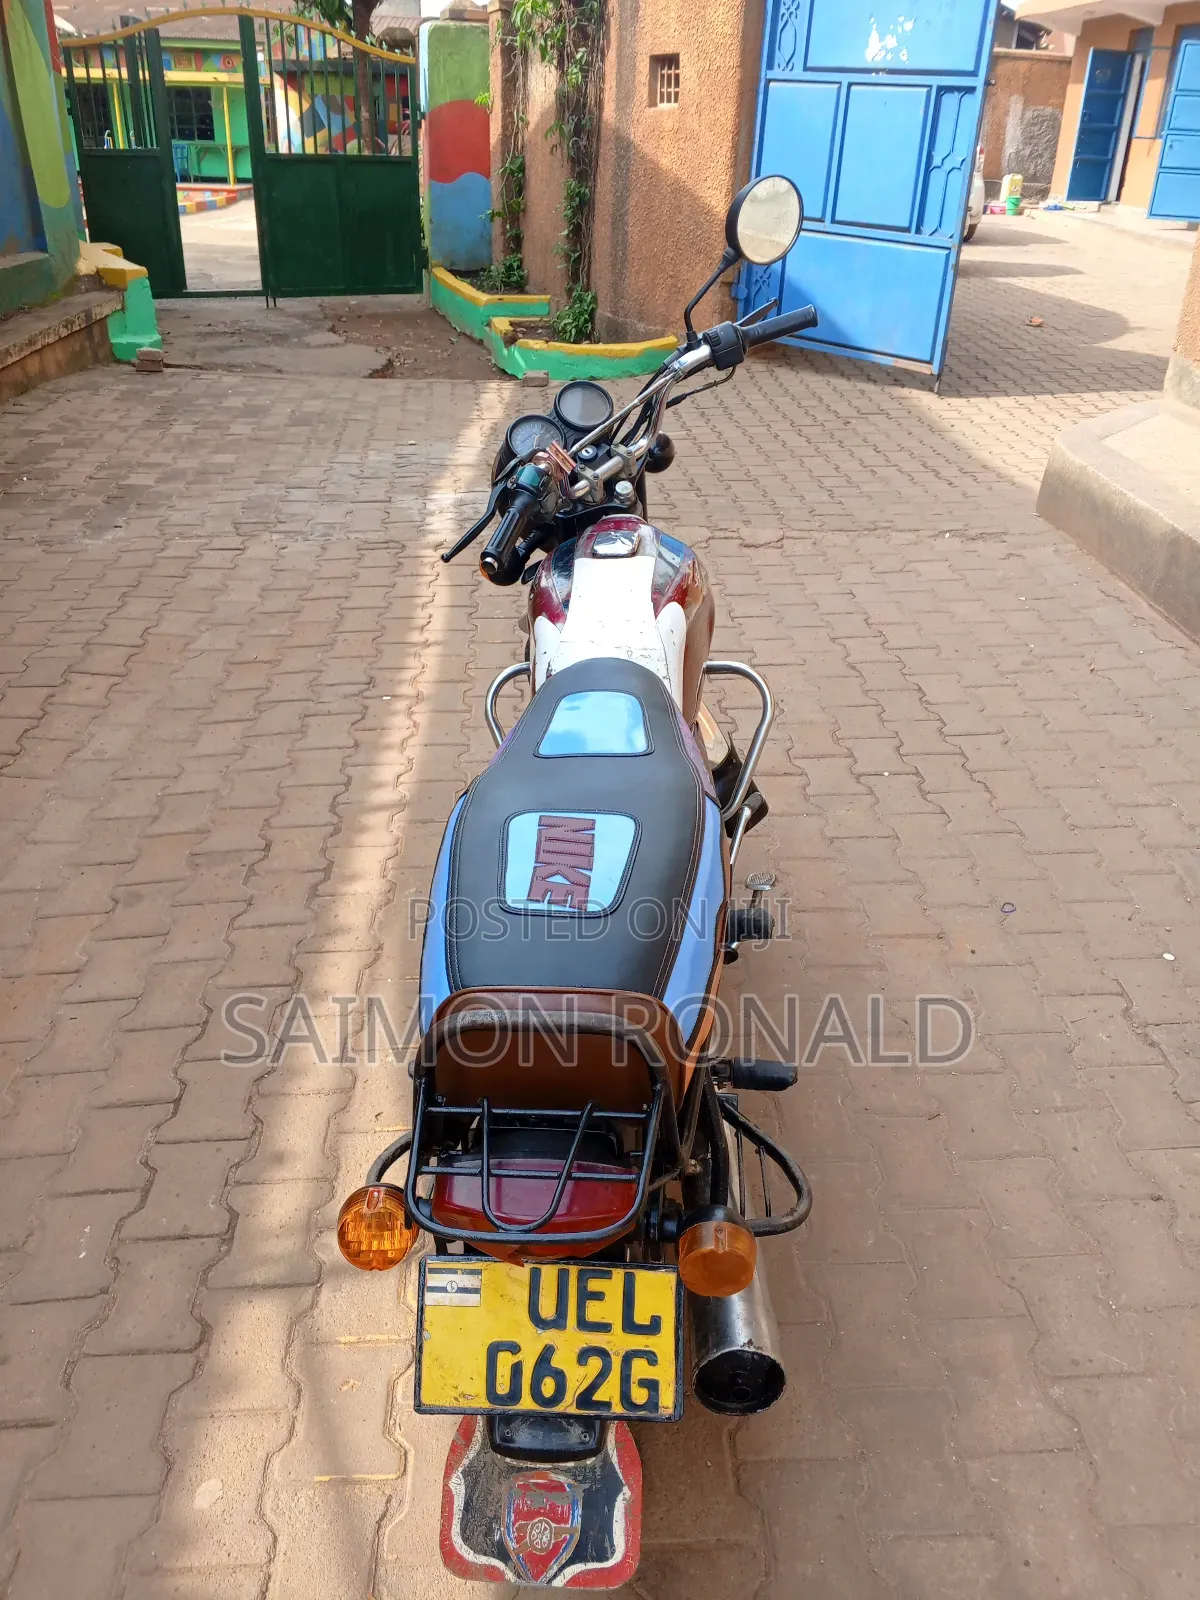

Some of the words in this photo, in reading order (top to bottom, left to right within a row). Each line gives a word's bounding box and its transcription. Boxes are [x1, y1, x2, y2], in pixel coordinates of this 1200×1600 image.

[527, 815, 596, 911] NIKE
[529, 1267, 662, 1335] UEL
[486, 1340, 661, 1414] 062G
